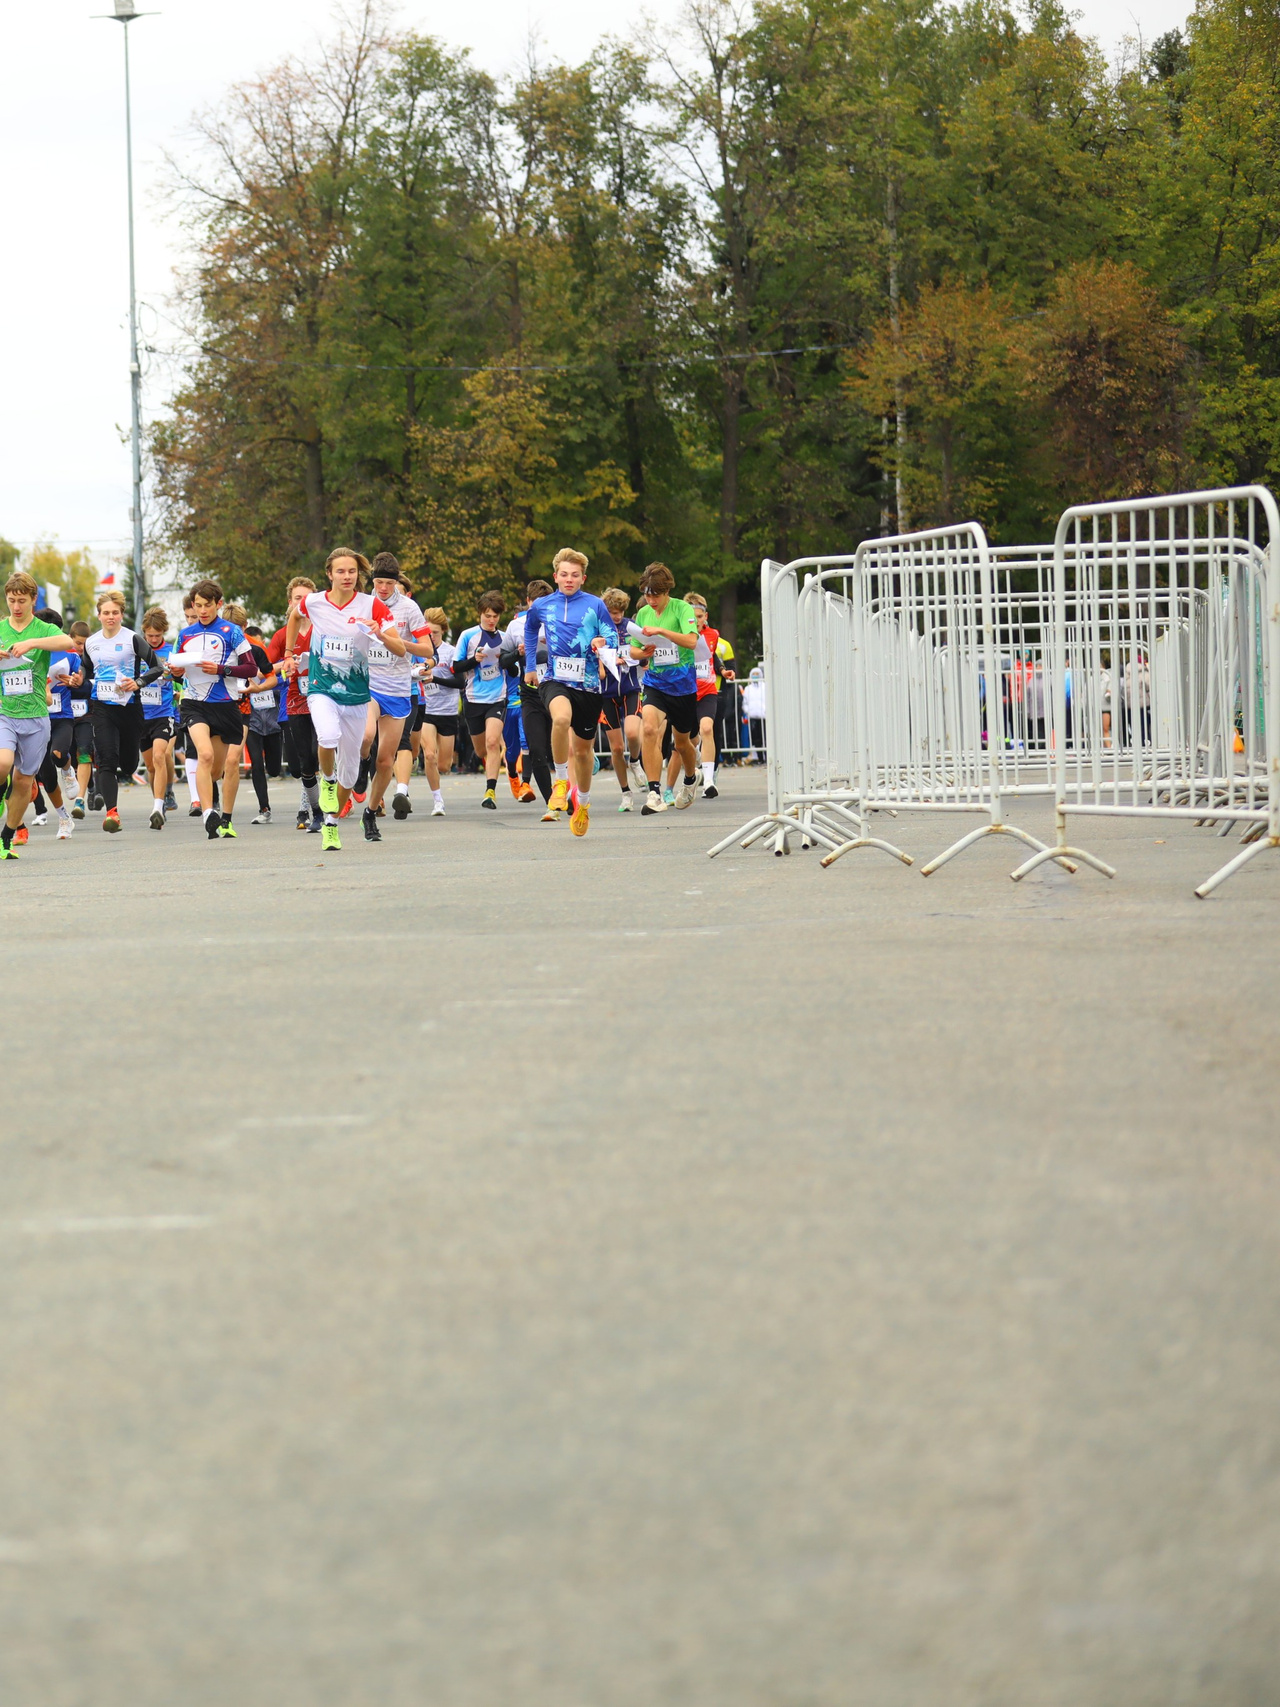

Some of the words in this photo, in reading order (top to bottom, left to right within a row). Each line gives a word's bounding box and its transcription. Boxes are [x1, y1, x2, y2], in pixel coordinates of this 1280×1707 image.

[324, 641, 349, 652] 314.1
[368, 649, 391, 658] 318.1
[654, 648, 674, 658] 320.1
[556, 661, 581, 673] 339.1
[5, 676, 28, 687] 312.1
[141, 690, 158, 699] 356.1
[253, 694, 271, 703] 358.1
